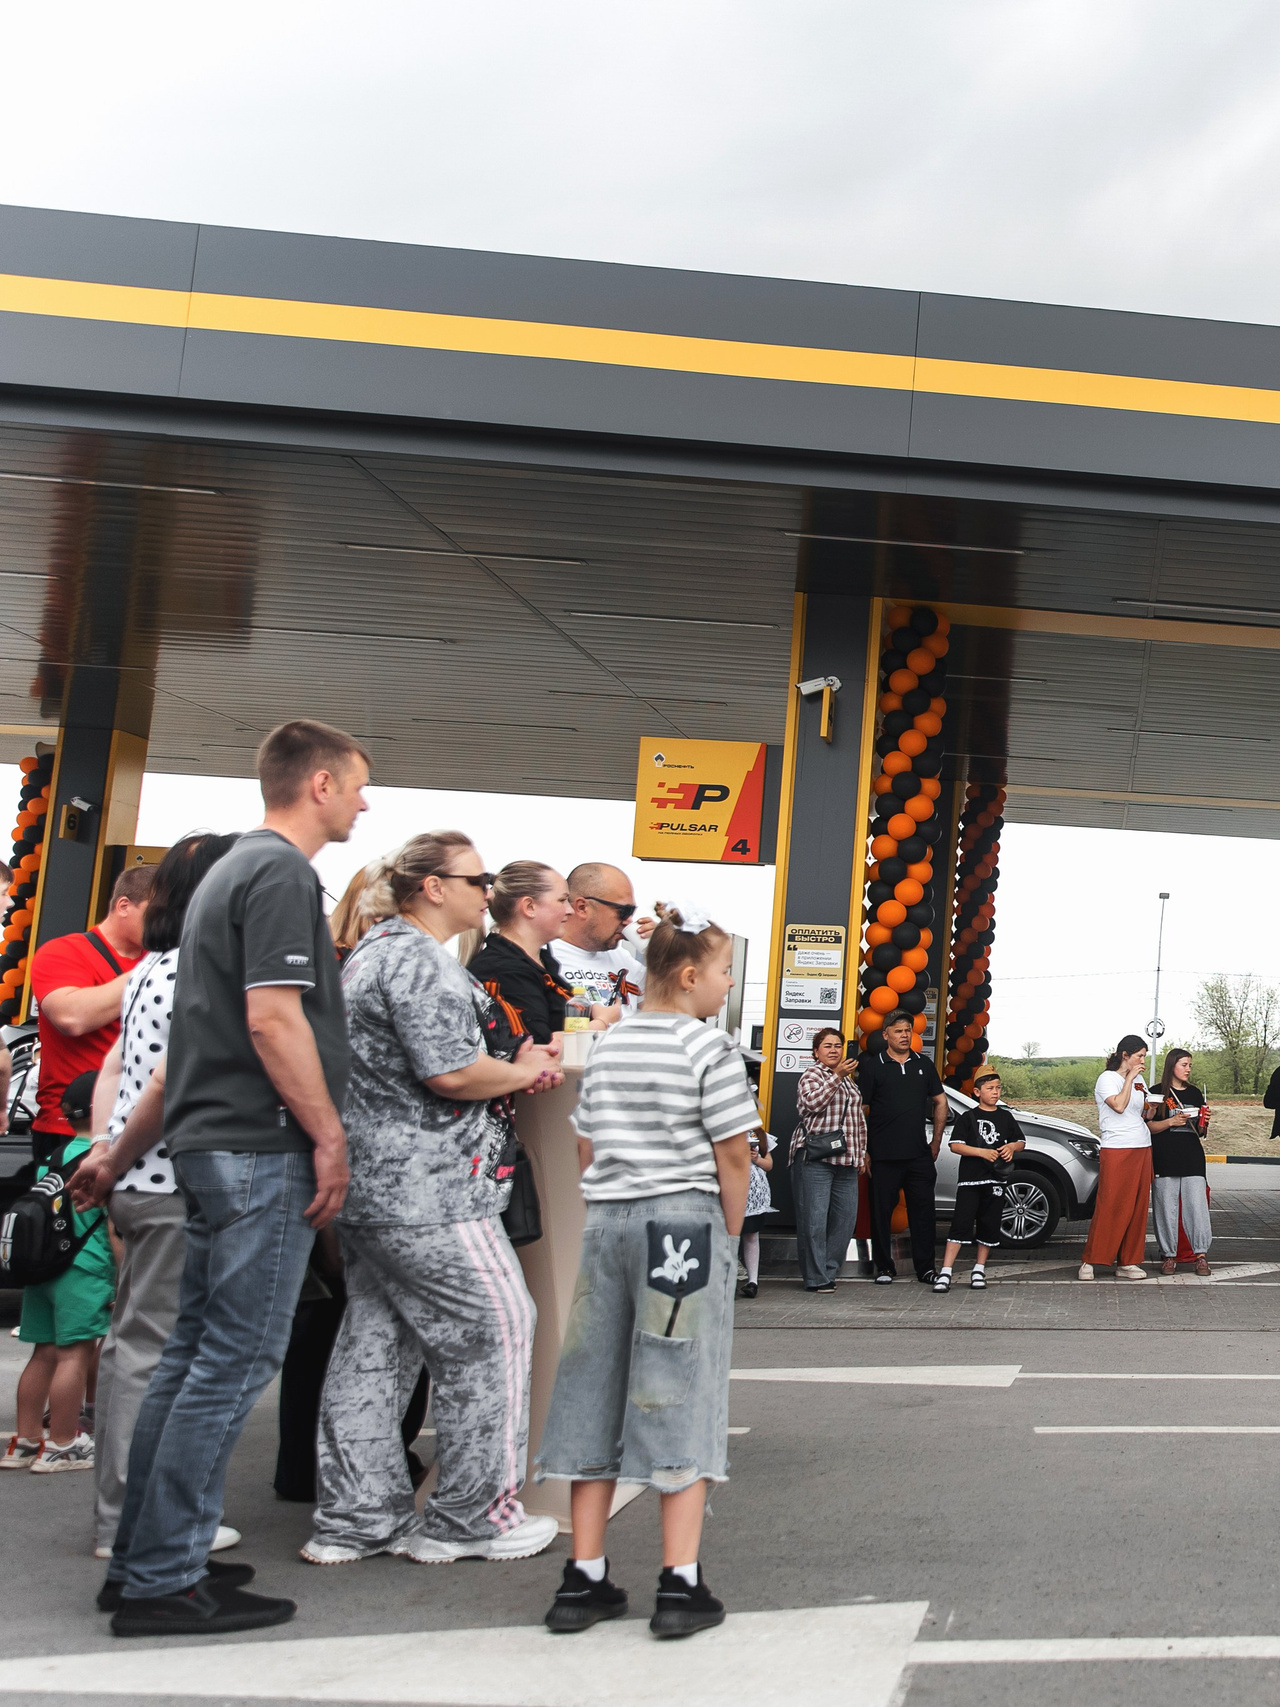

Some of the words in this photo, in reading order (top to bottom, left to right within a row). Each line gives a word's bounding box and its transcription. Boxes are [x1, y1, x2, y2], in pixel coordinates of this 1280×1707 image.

[67, 813, 77, 830] 6
[659, 822, 719, 832] PULSAR
[731, 839, 751, 855] 4
[564, 969, 608, 980] adidas
